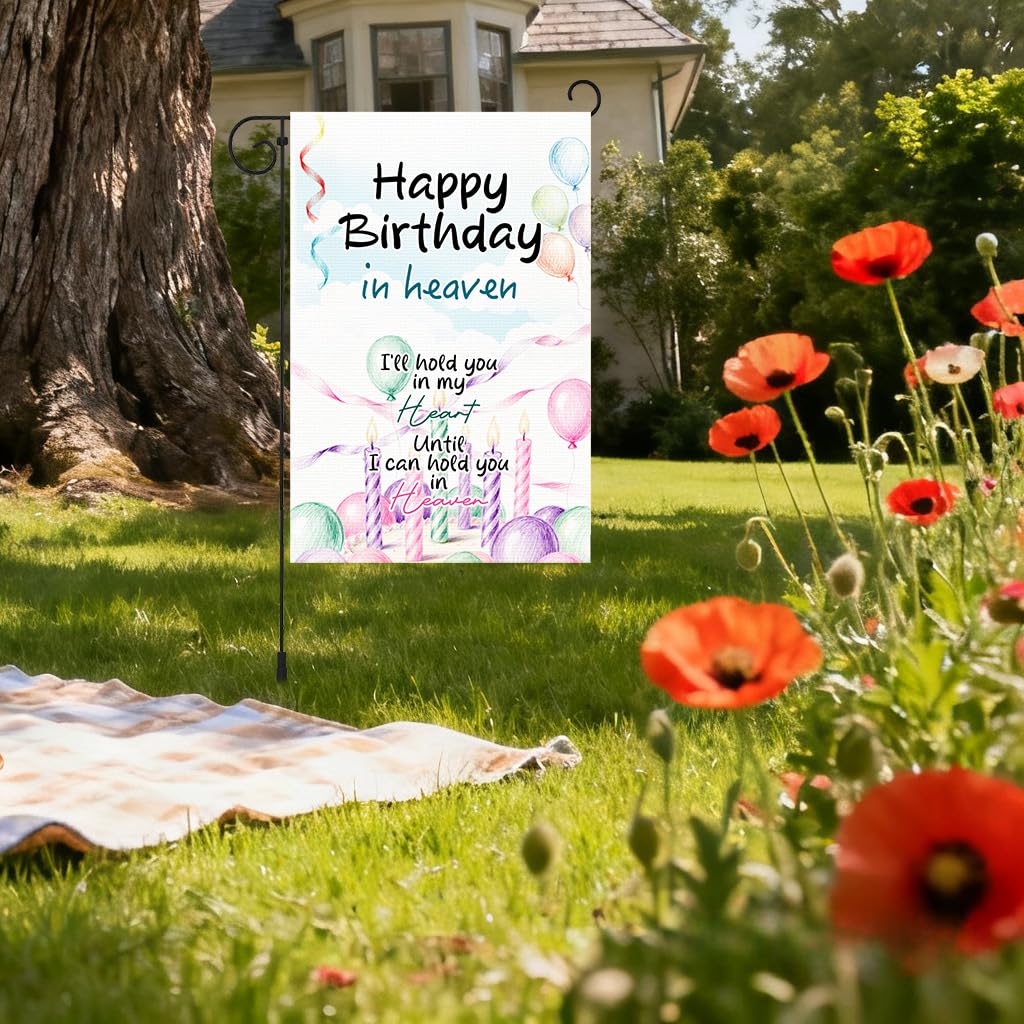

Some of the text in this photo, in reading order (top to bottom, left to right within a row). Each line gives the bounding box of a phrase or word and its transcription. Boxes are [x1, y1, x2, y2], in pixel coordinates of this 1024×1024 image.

[372, 161, 508, 214] Happy
[338, 212, 542, 264] Birthday
[362, 262, 517, 300] in heaven
[380, 353, 498, 377] I'll hold you
[413, 373, 465, 396] in my
[397, 394, 481, 427] Heart
[413, 434, 465, 453] Until
[368, 453, 509, 477] I can hold you
[430, 474, 448, 490] in
[390, 481, 489, 515] Heaven
